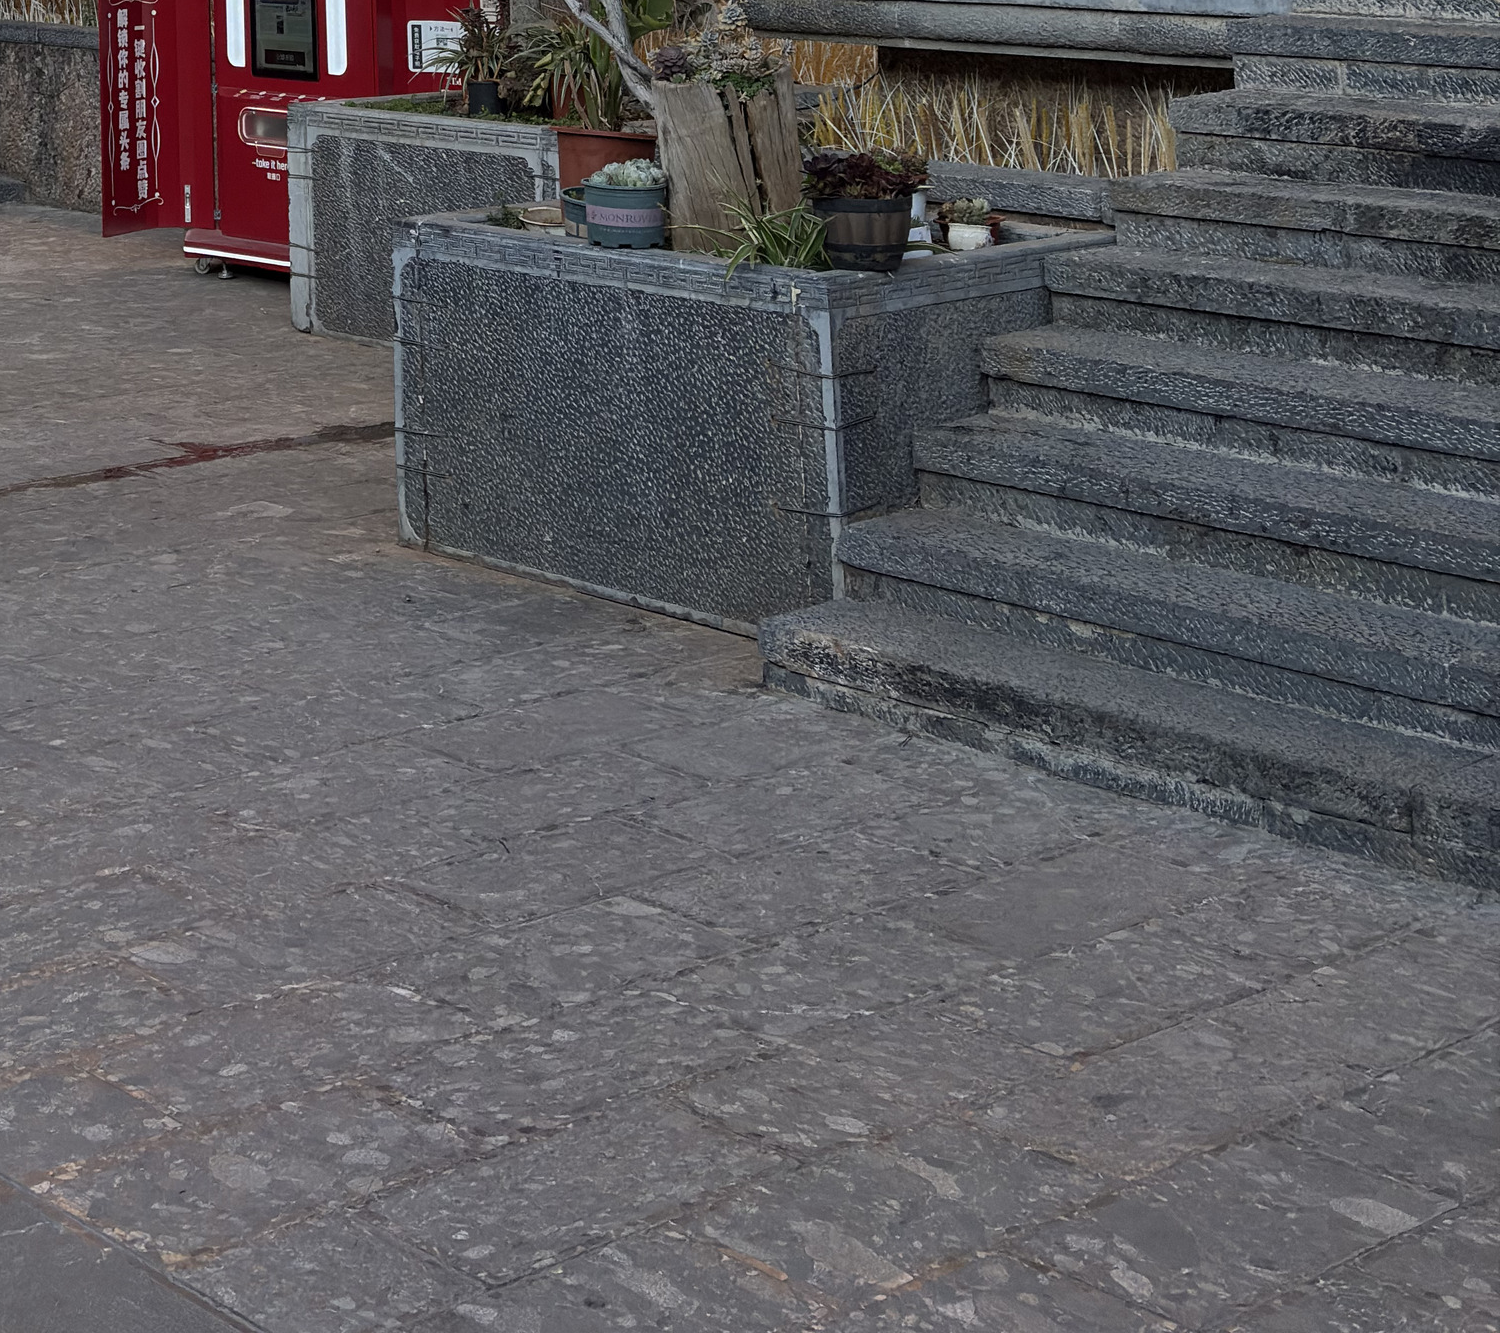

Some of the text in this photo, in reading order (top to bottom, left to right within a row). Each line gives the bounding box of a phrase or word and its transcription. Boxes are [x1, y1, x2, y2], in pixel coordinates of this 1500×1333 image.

[116, 8, 130, 171] 解锁你的专属头条
[133, 25, 149, 200] 一键收割朋友圈点赞
